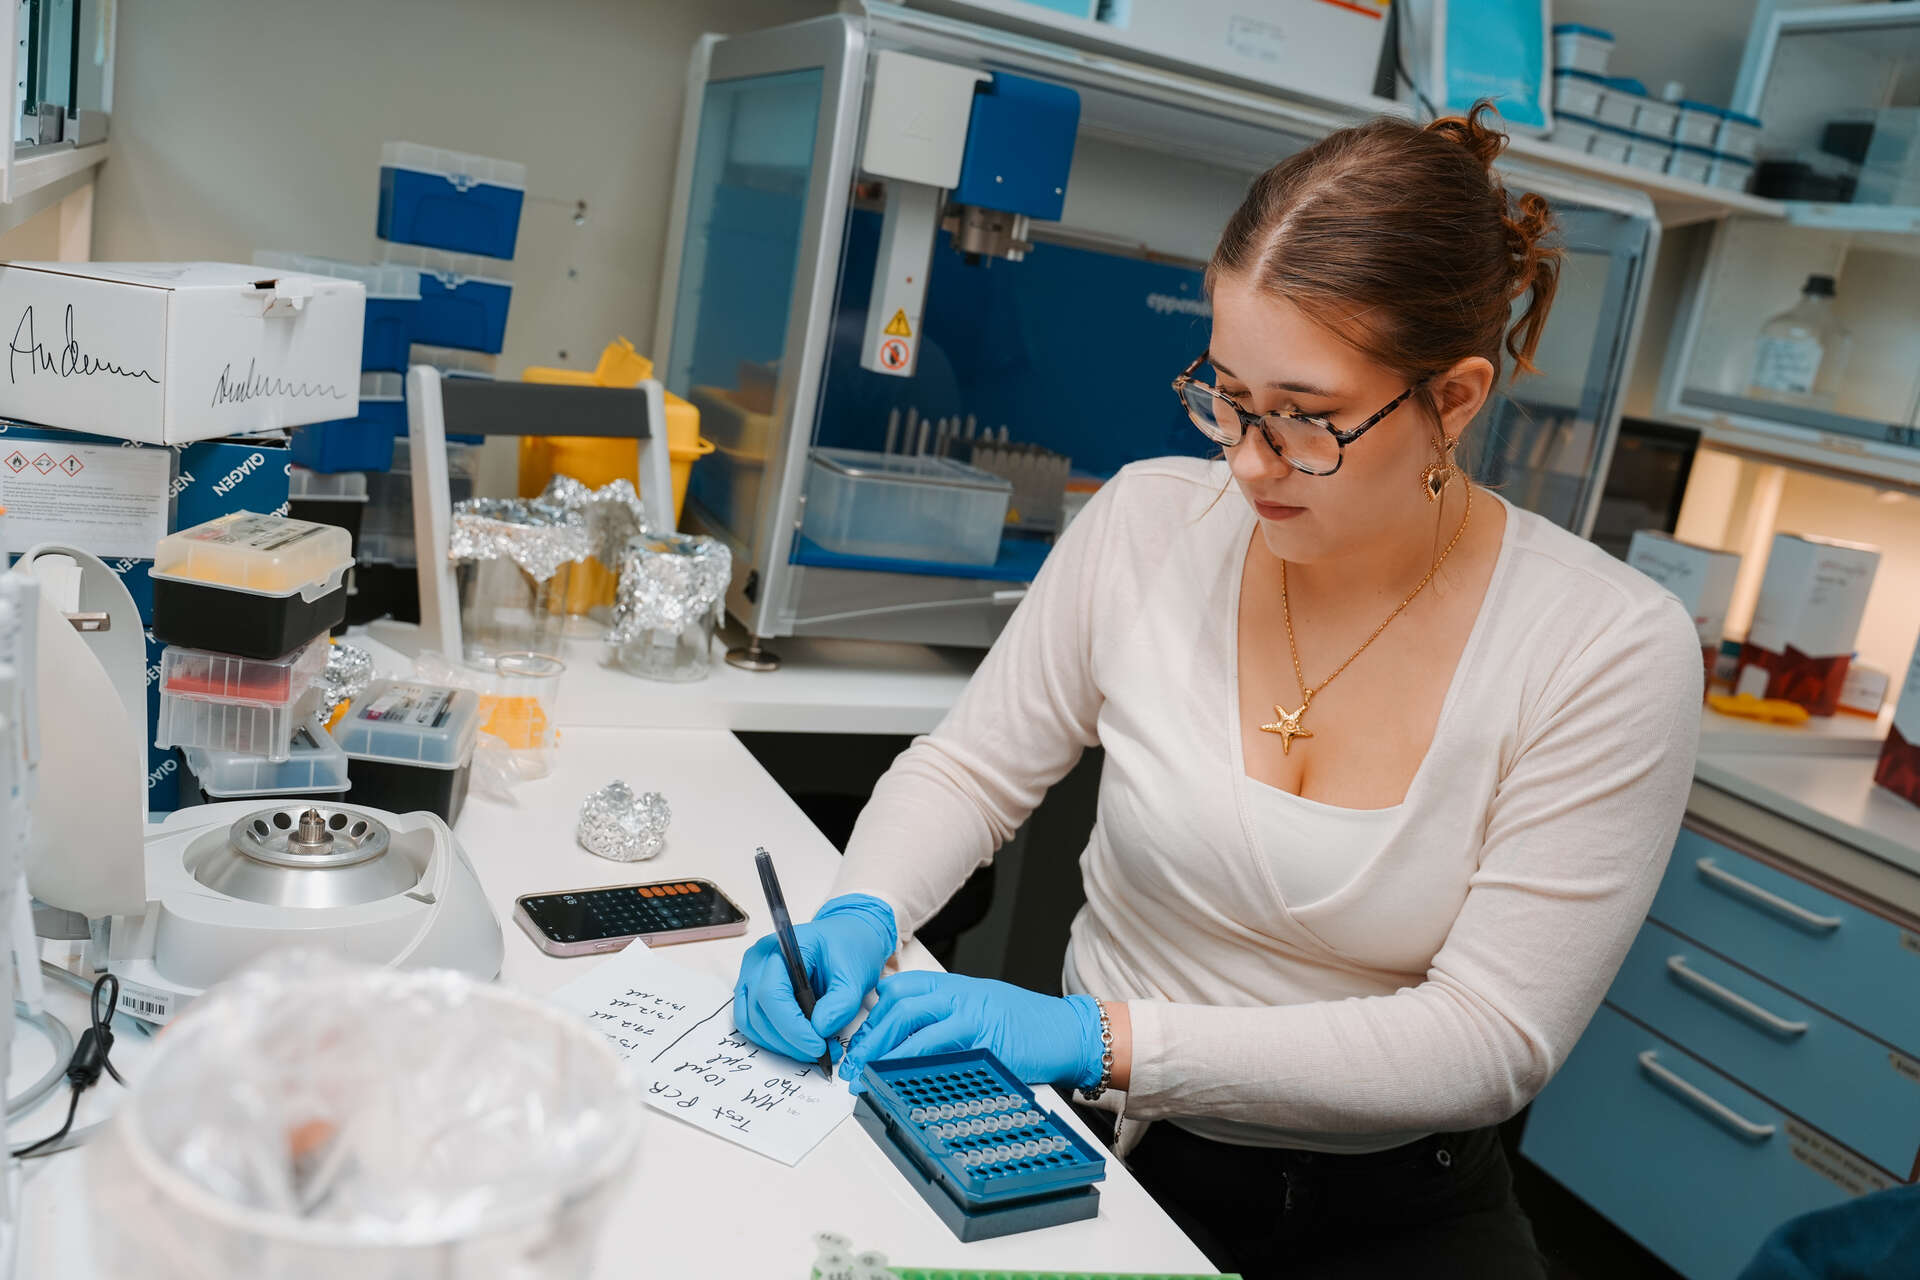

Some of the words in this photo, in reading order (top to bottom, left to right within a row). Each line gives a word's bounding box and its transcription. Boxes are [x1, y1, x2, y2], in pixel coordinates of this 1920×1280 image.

[211, 452, 265, 497] QIAGEN
[649, 1081, 699, 1108] PCR
[713, 1106, 751, 1133] Test
